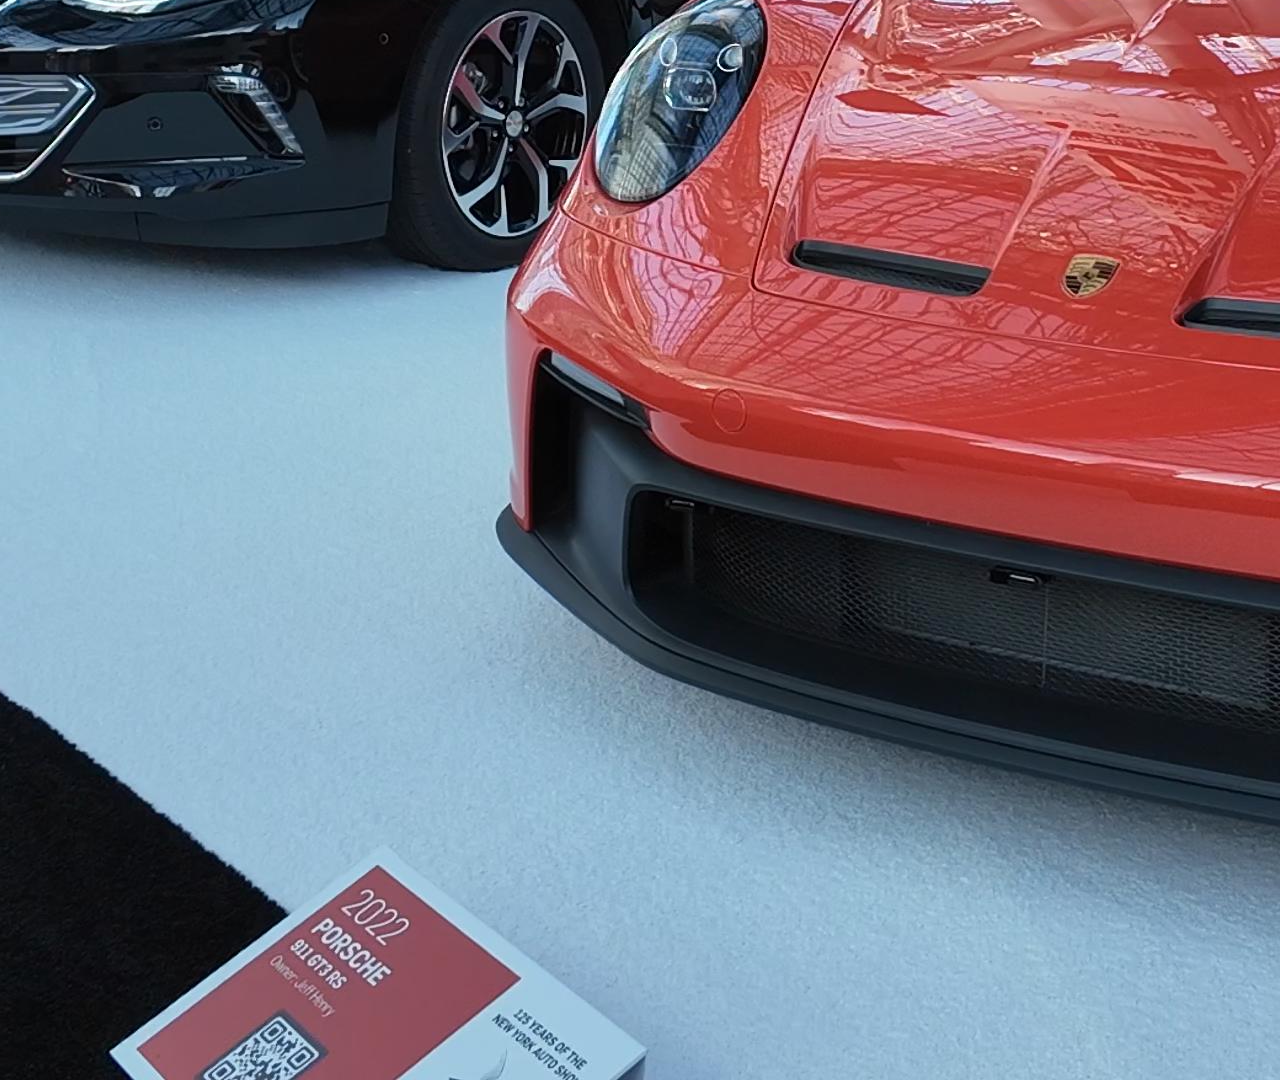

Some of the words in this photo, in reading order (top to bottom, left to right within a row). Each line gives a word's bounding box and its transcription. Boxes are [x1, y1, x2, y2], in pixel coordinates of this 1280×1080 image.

[341, 889, 409, 946] 2022
[290, 939, 314, 960] 911
[308, 954, 333, 977] GT3
[325, 970, 347, 989] RS
[311, 918, 391, 986] PORSCHE
[492, 1013, 515, 1033] NEW
[511, 1027, 535, 1052] YORK
[532, 1047, 558, 1070] AUTO
[513, 1008, 532, 1026] 125
[528, 1020, 558, 1047] YEARS
[554, 1041, 571, 1055] OF
[568, 1050, 589, 1071] THE
